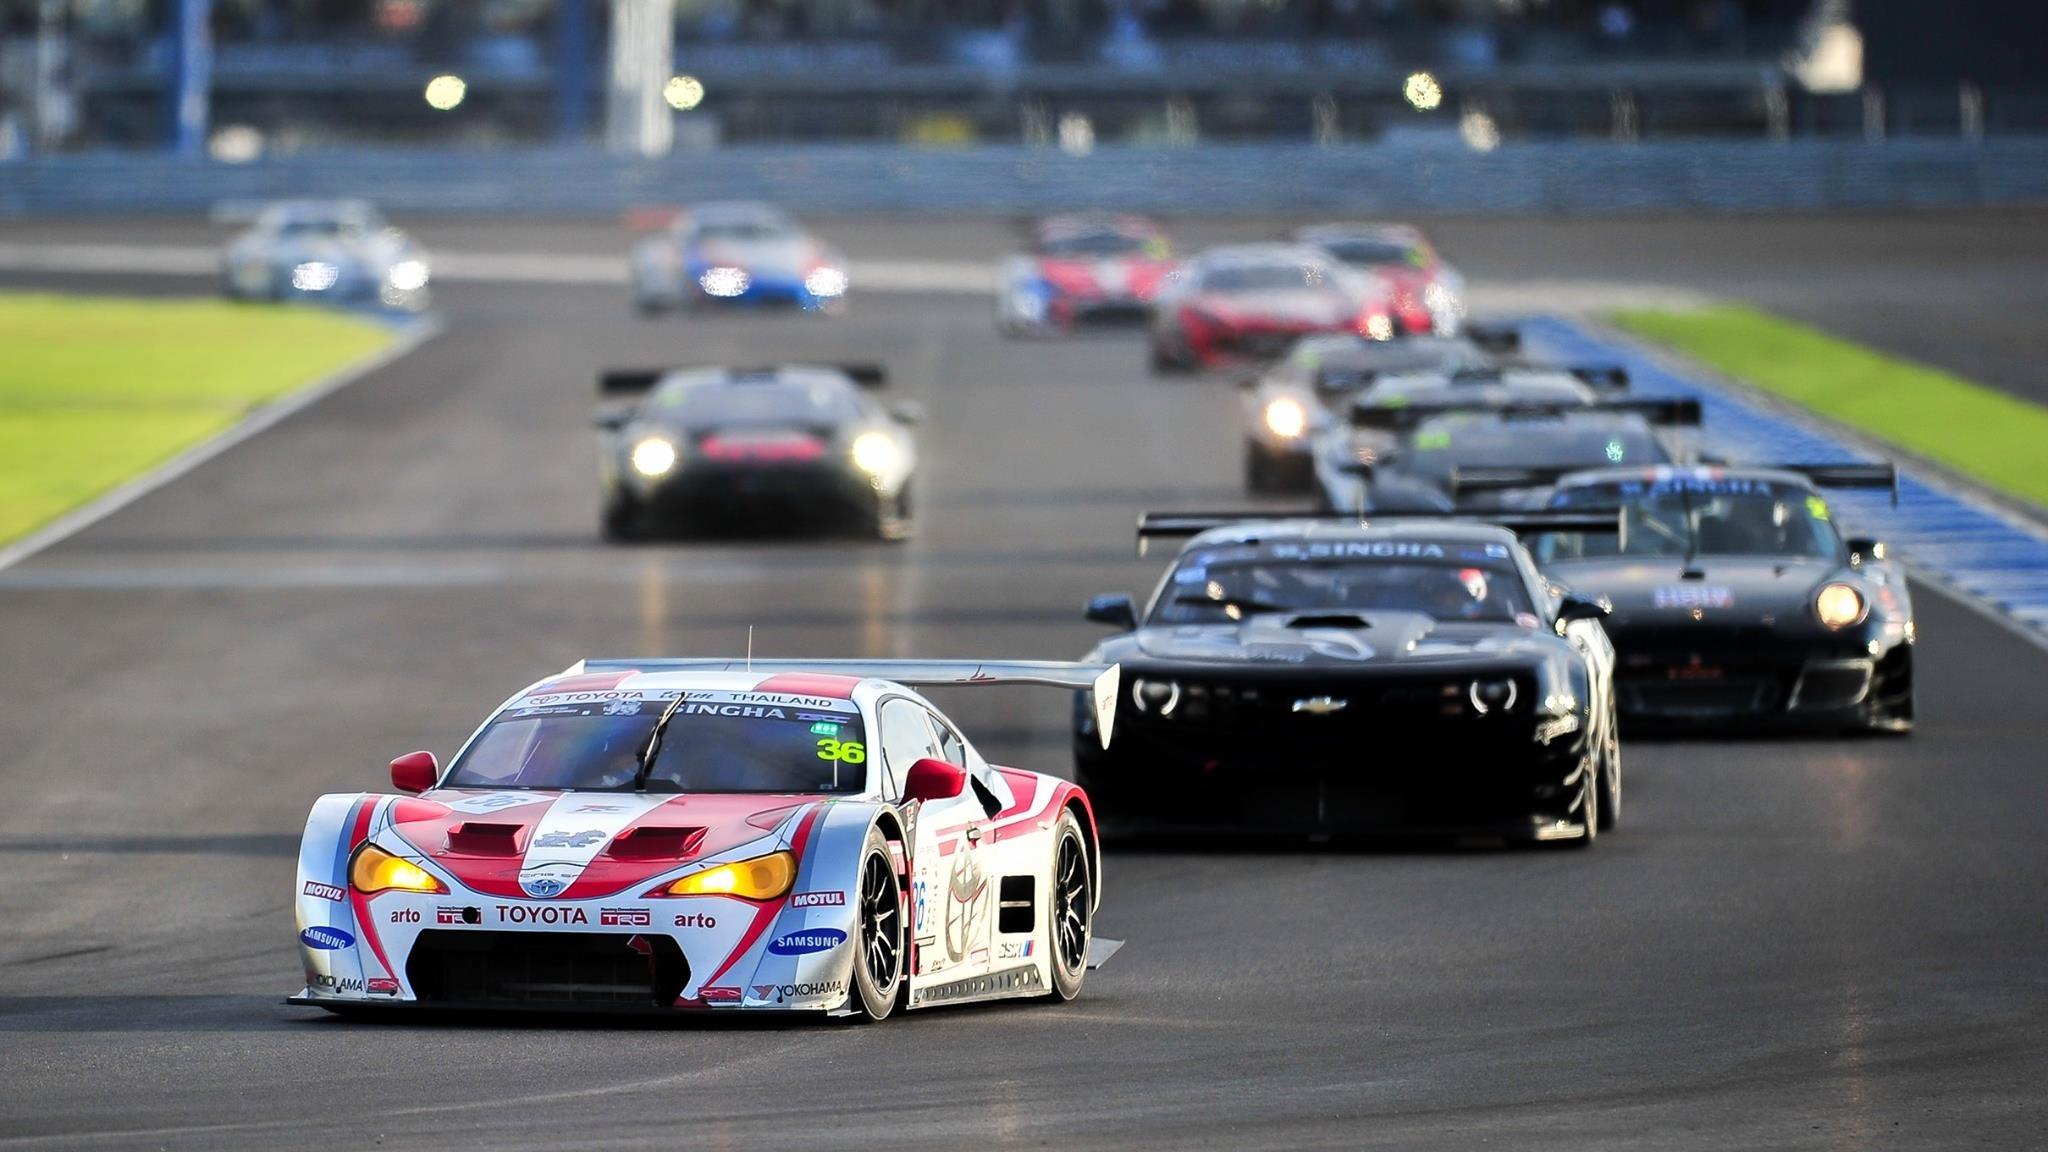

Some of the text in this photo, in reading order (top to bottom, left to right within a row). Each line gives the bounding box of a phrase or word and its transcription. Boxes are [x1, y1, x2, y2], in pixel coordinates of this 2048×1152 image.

[1309, 543, 1444, 558] SINGHA
[563, 691, 644, 701] TOYOTA
[730, 693, 832, 708] THAILAND
[674, 704, 786, 719] SINGHA
[816, 738, 865, 764] 36
[305, 882, 344, 901] MOTUL
[794, 892, 844, 907] MOTUL
[390, 907, 421, 923] arto
[438, 912, 480, 925] TR
[496, 905, 589, 925] TOYOTA
[602, 914, 649, 927] TRD
[674, 912, 716, 929] arto
[304, 928, 347, 950] SAMSUNG
[777, 936, 840, 948] SAMSUNG
[314, 973, 363, 992] OKOAMA
[776, 980, 842, 999] YOKOHAMA
